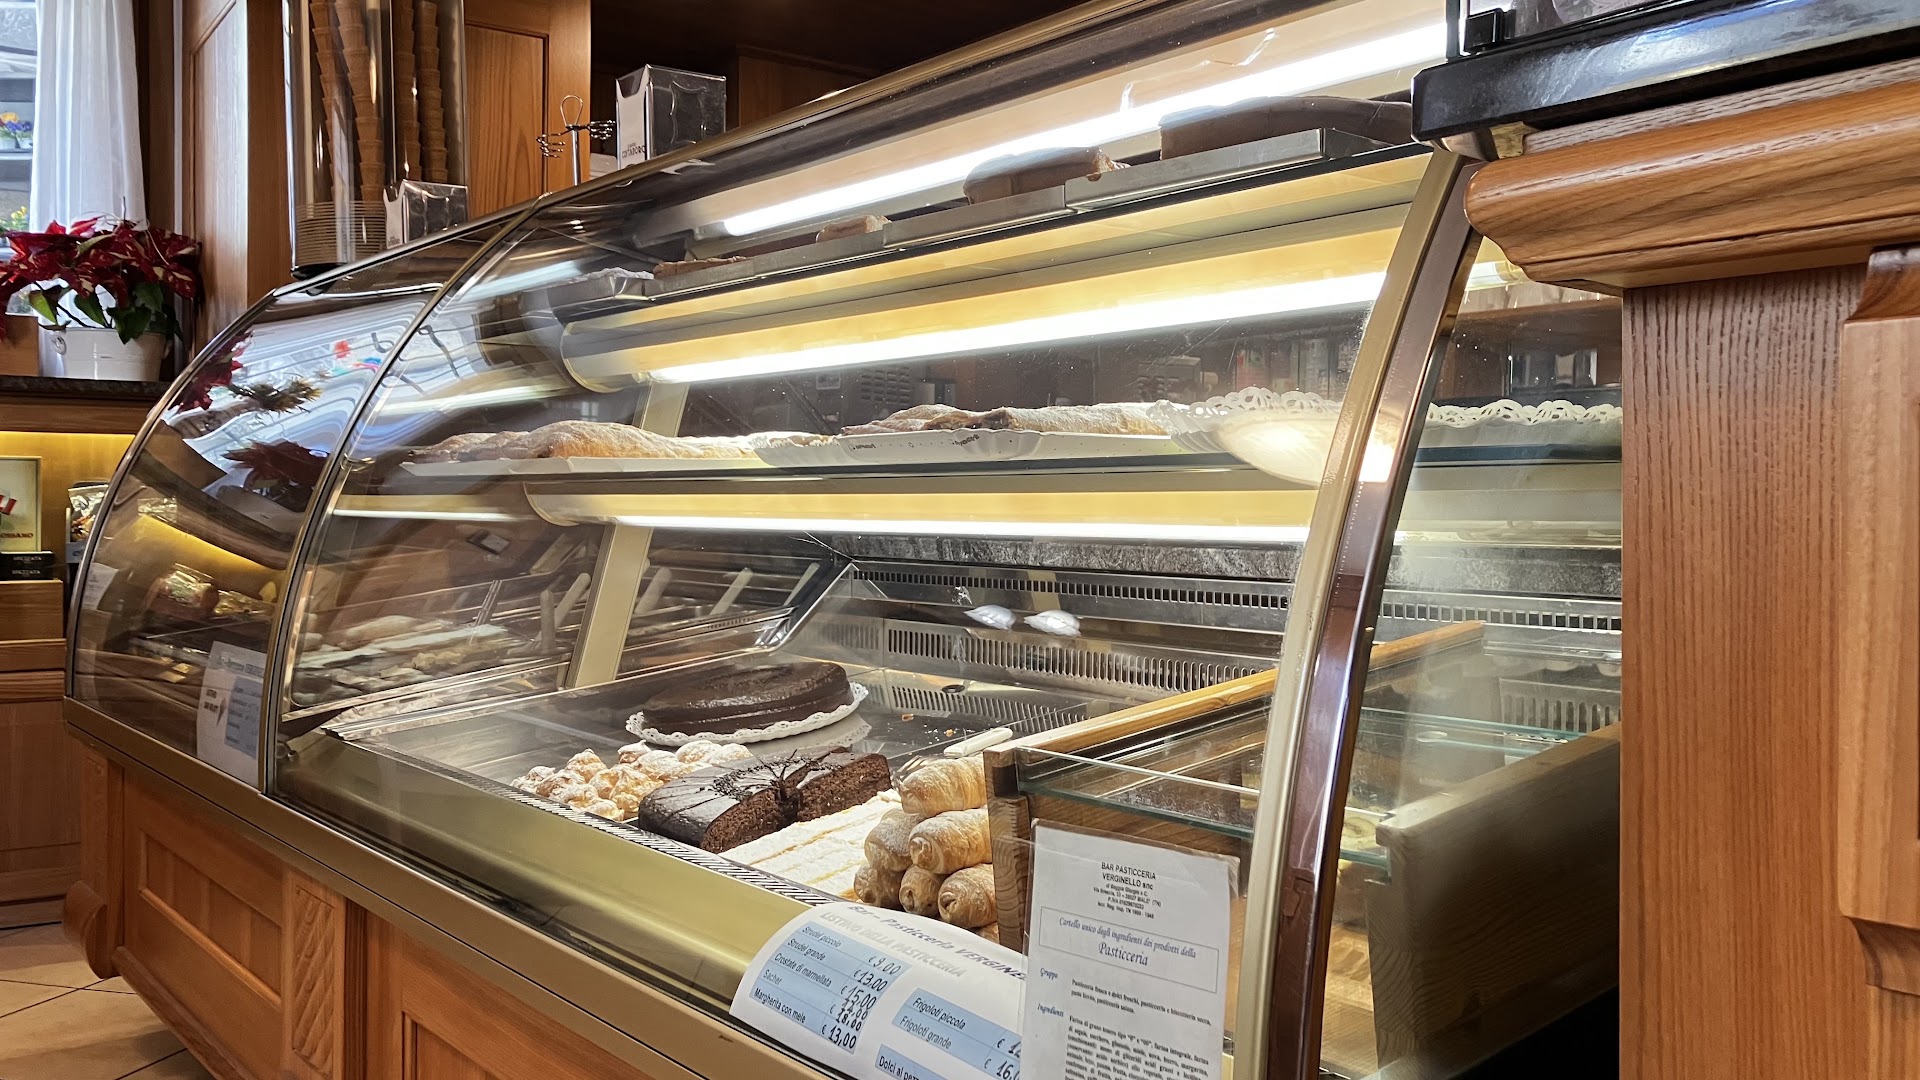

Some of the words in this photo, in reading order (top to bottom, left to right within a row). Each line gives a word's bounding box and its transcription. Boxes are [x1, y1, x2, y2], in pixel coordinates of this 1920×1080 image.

[1102, 862, 1114, 871] BAR
[1116, 865, 1156, 880] PASTICCERIA
[1102, 872, 1141, 887] VERGINELLO
[1142, 882, 1153, 890] snc
[802, 926, 823, 940] Strudel
[818, 934, 842, 948] piccolo
[848, 906, 874, 915] Bar
[880, 918, 954, 950] Pasticceria
[1059, 916, 1081, 929] Cartello
[1081, 923, 1096, 933] unico
[1097, 925, 1110, 938] degli
[1112, 930, 1143, 945] ingredienti
[1143, 937, 1153, 947] dei
[1153, 942, 1179, 954] prodotti
[1180, 946, 1196, 958] della
[788, 938, 810, 952] Strudel
[803, 947, 826, 961] grande
[820, 912, 862, 932] LISTINO
[858, 928, 895, 947] DELLA
[892, 942, 967, 977] PASTICCERIA
[1098, 941, 1148, 966] Pasticceria
[763, 969, 782, 986] Sacher
[774, 952, 797, 970] Crostate
[796, 963, 804, 973] di
[801, 967, 832, 988] marmellata
[754, 987, 782, 1010] Margherita
[781, 1004, 792, 1015] con
[828, 1025, 857, 1049] 13,00
[912, 997, 941, 1017] Frigoloti
[938, 1012, 966, 1030] piccola
[900, 1015, 928, 1035] Frigoloti
[926, 1031, 952, 1050] grande
[879, 1055, 897, 1074] Dolci
[896, 1066, 904, 1078] al
